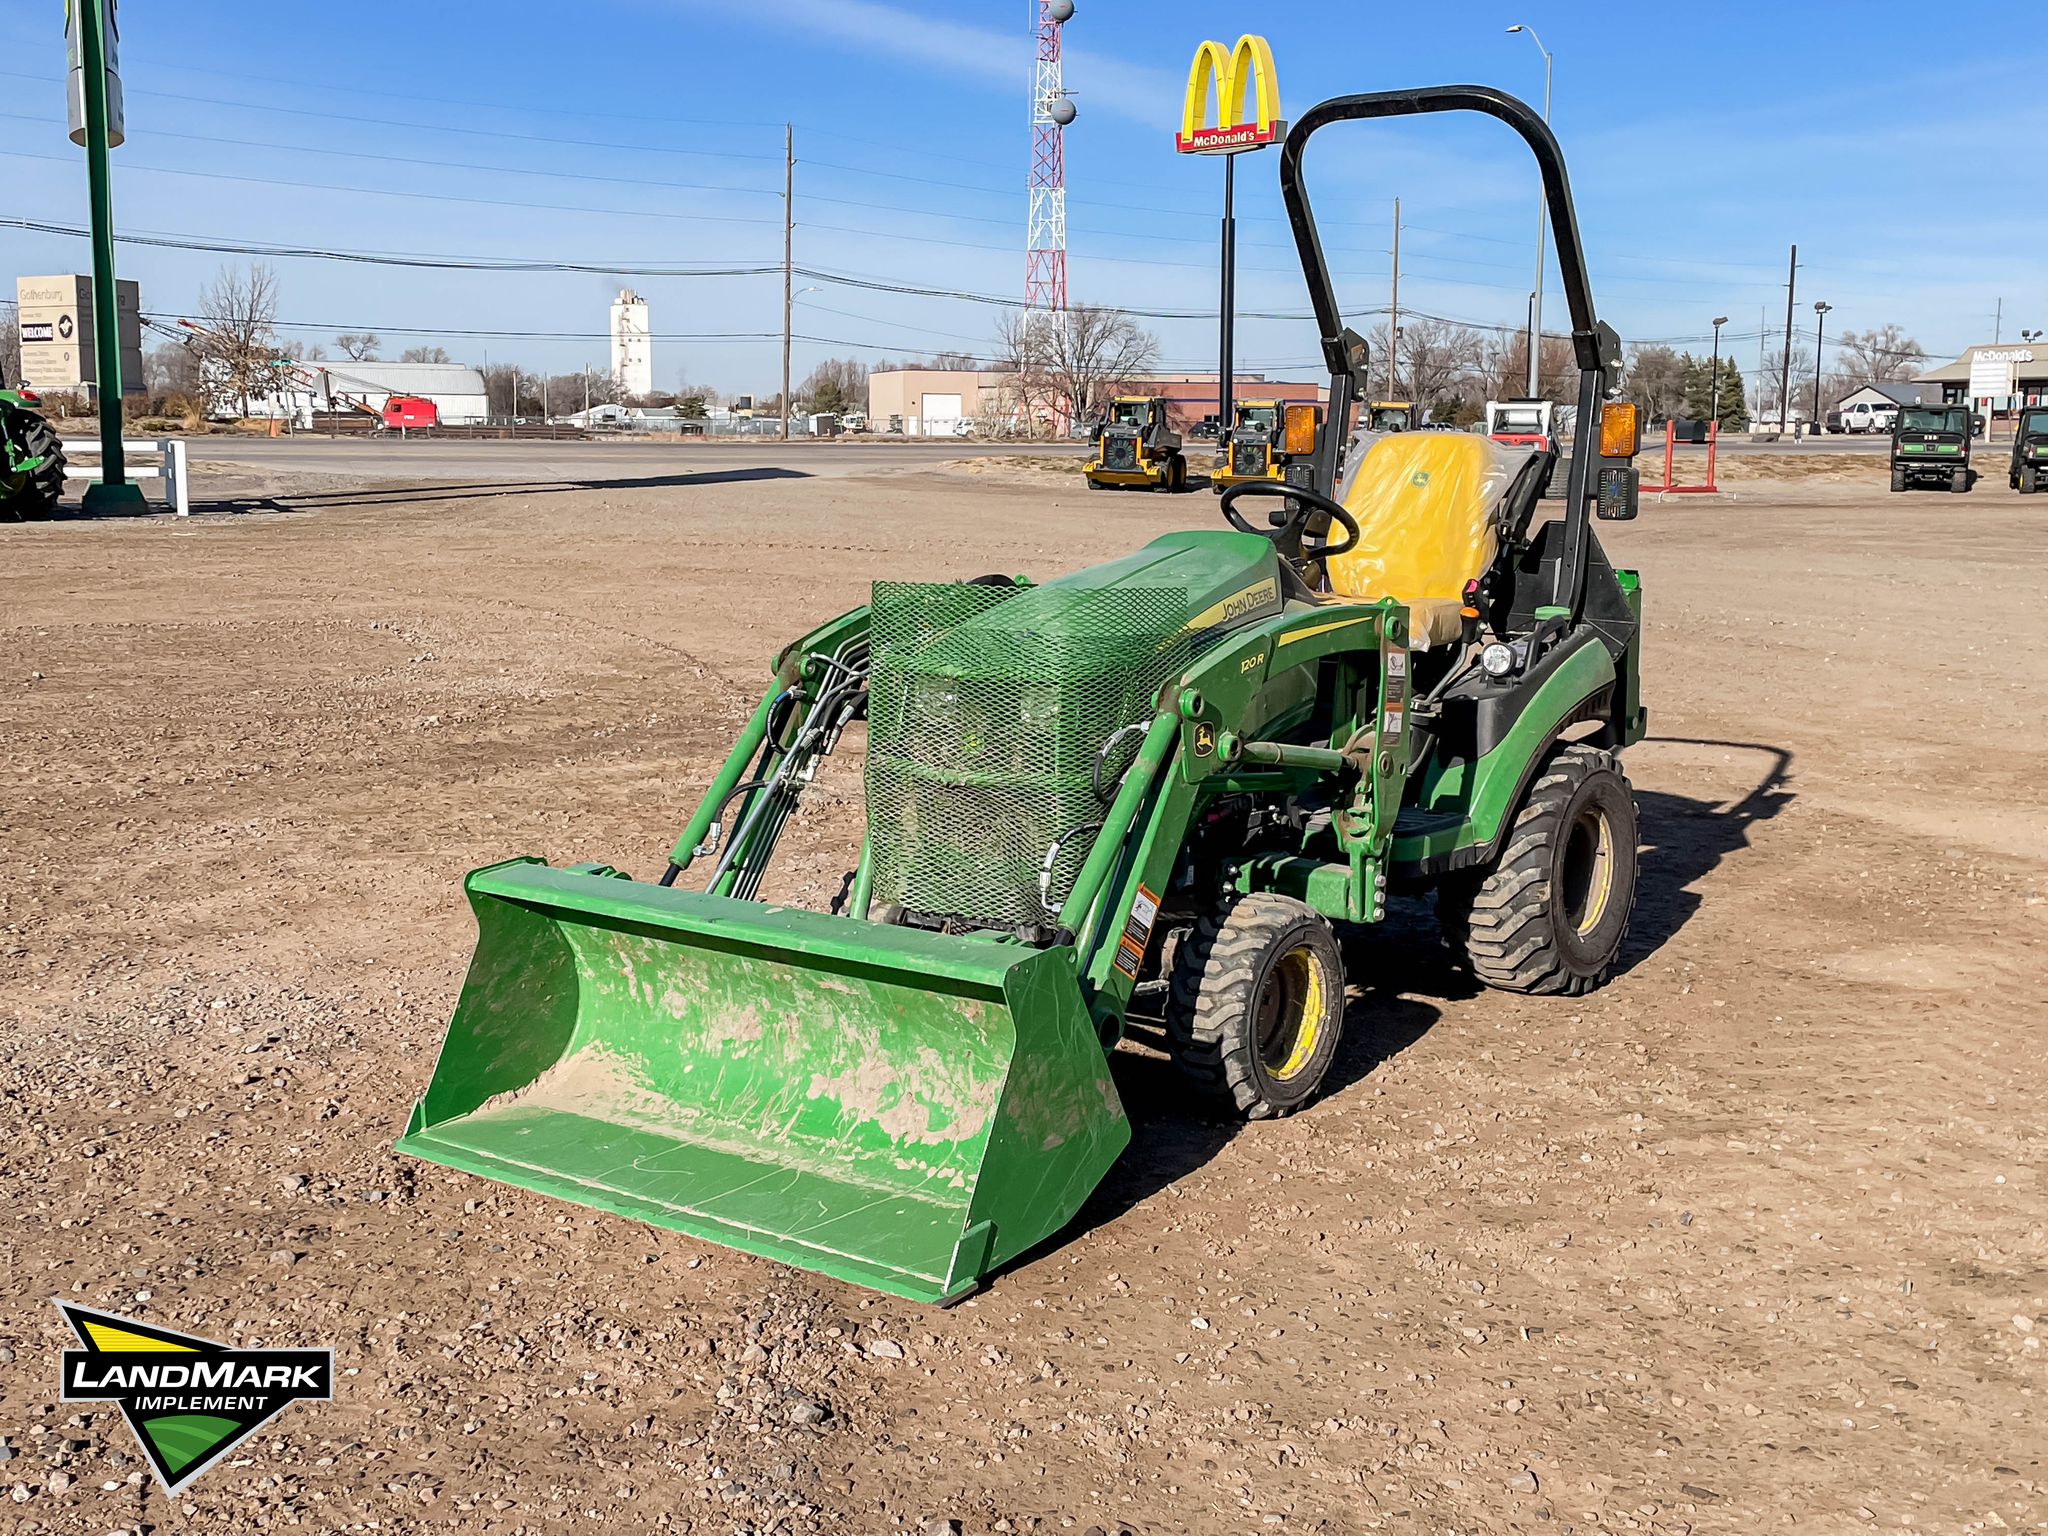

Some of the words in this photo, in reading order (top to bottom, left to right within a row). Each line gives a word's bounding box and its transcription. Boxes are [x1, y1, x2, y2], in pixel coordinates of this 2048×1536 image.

[1193, 131, 1255, 147] McDonald's
[20, 288, 63, 302] Gothenburg
[21, 326, 53, 338] WELCOME
[1973, 349, 2033, 362] McDonald's
[1222, 597, 1247, 620] JOHN
[1246, 587, 1275, 608] DEERE
